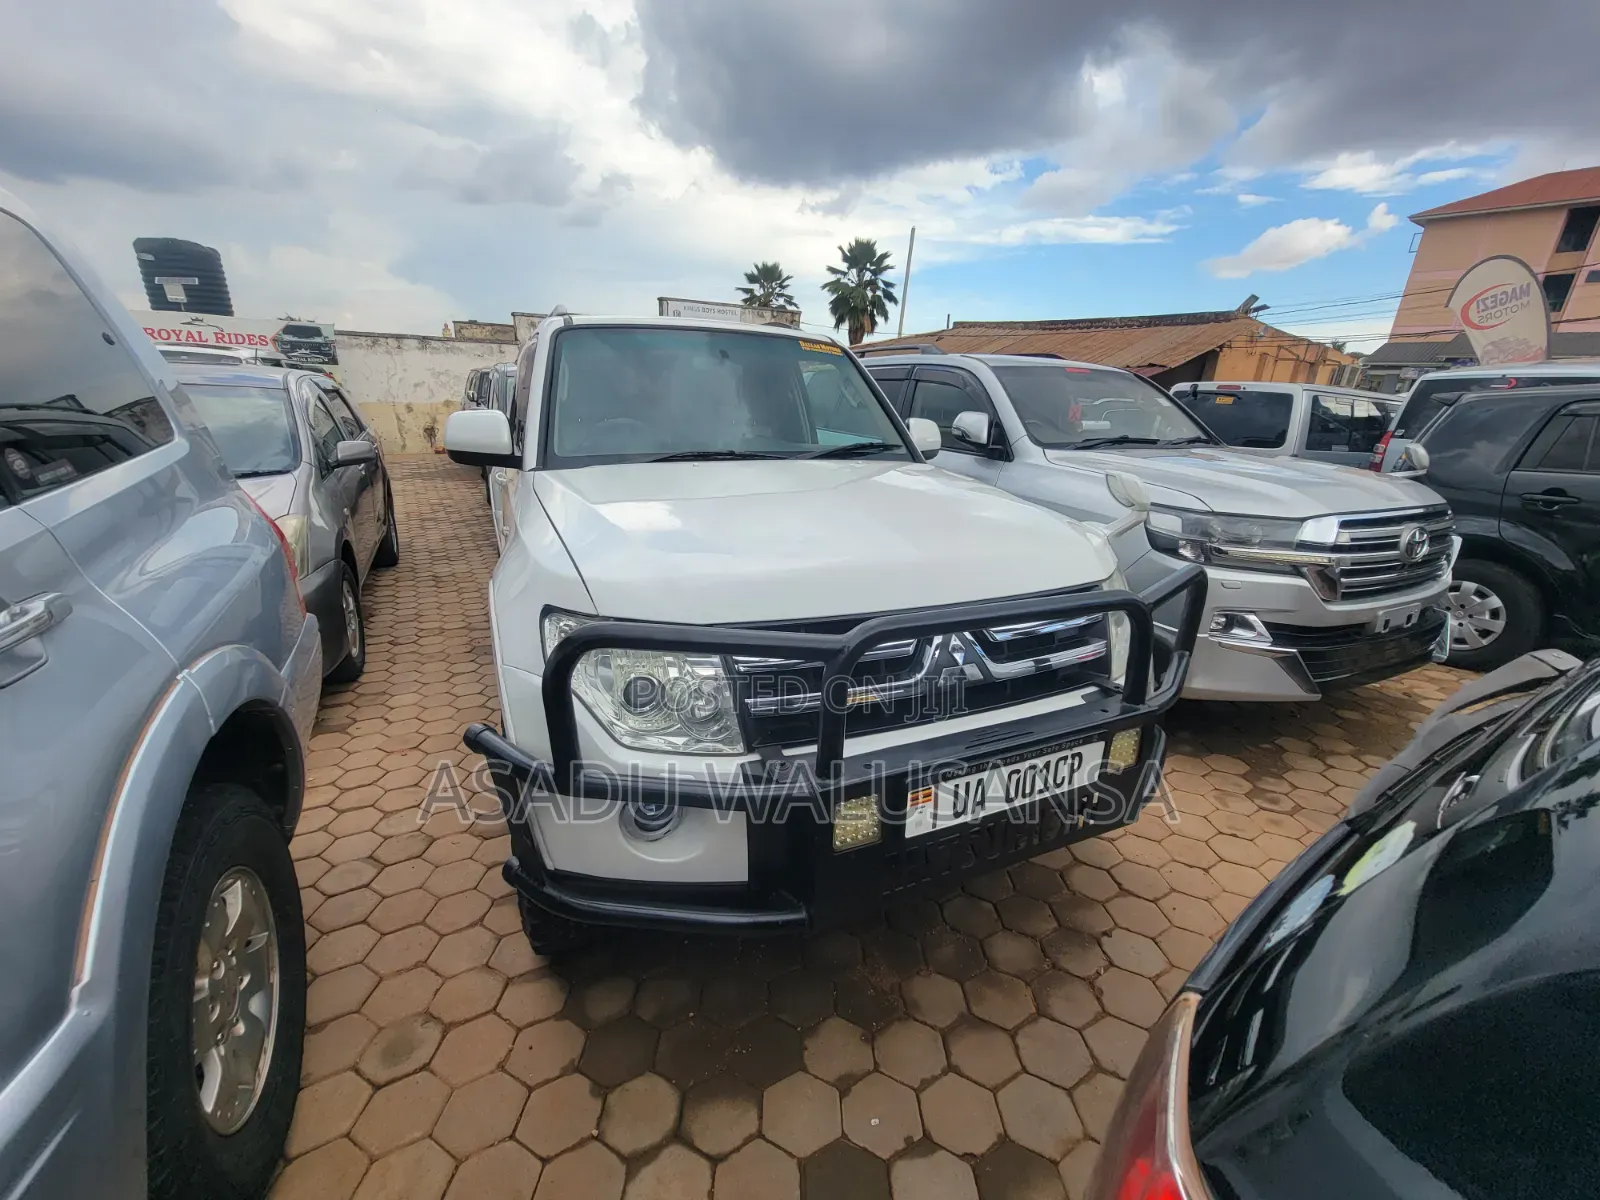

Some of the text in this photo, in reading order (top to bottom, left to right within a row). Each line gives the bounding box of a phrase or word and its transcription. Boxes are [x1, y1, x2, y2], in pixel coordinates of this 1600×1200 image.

[143, 327, 269, 346] ROYAL RIDES
[1061, 738, 1084, 749] Space
[952, 751, 1083, 819] UA 001CP
